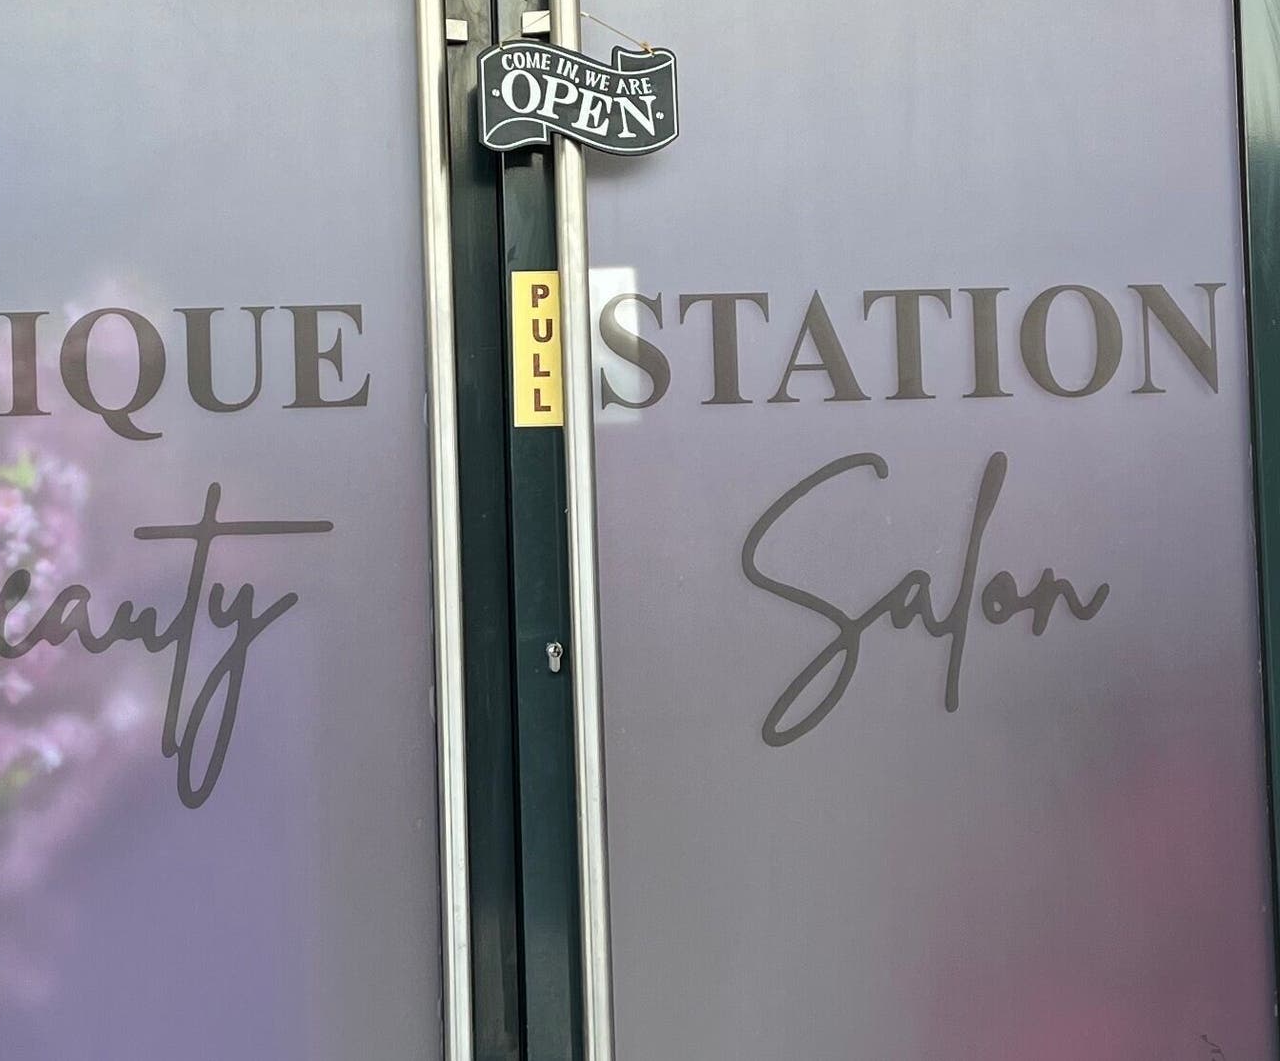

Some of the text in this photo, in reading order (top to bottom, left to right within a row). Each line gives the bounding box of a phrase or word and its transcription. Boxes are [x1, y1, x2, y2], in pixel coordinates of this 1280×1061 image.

[501, 51, 551, 71] COME
[586, 69, 611, 91] WE
[616, 77, 653, 95] ARE
[501, 69, 657, 138] OPEN
[531, 284, 553, 412] PULL
[599, 283, 1226, 409] STATION
[741, 451, 1110, 747] Salon
